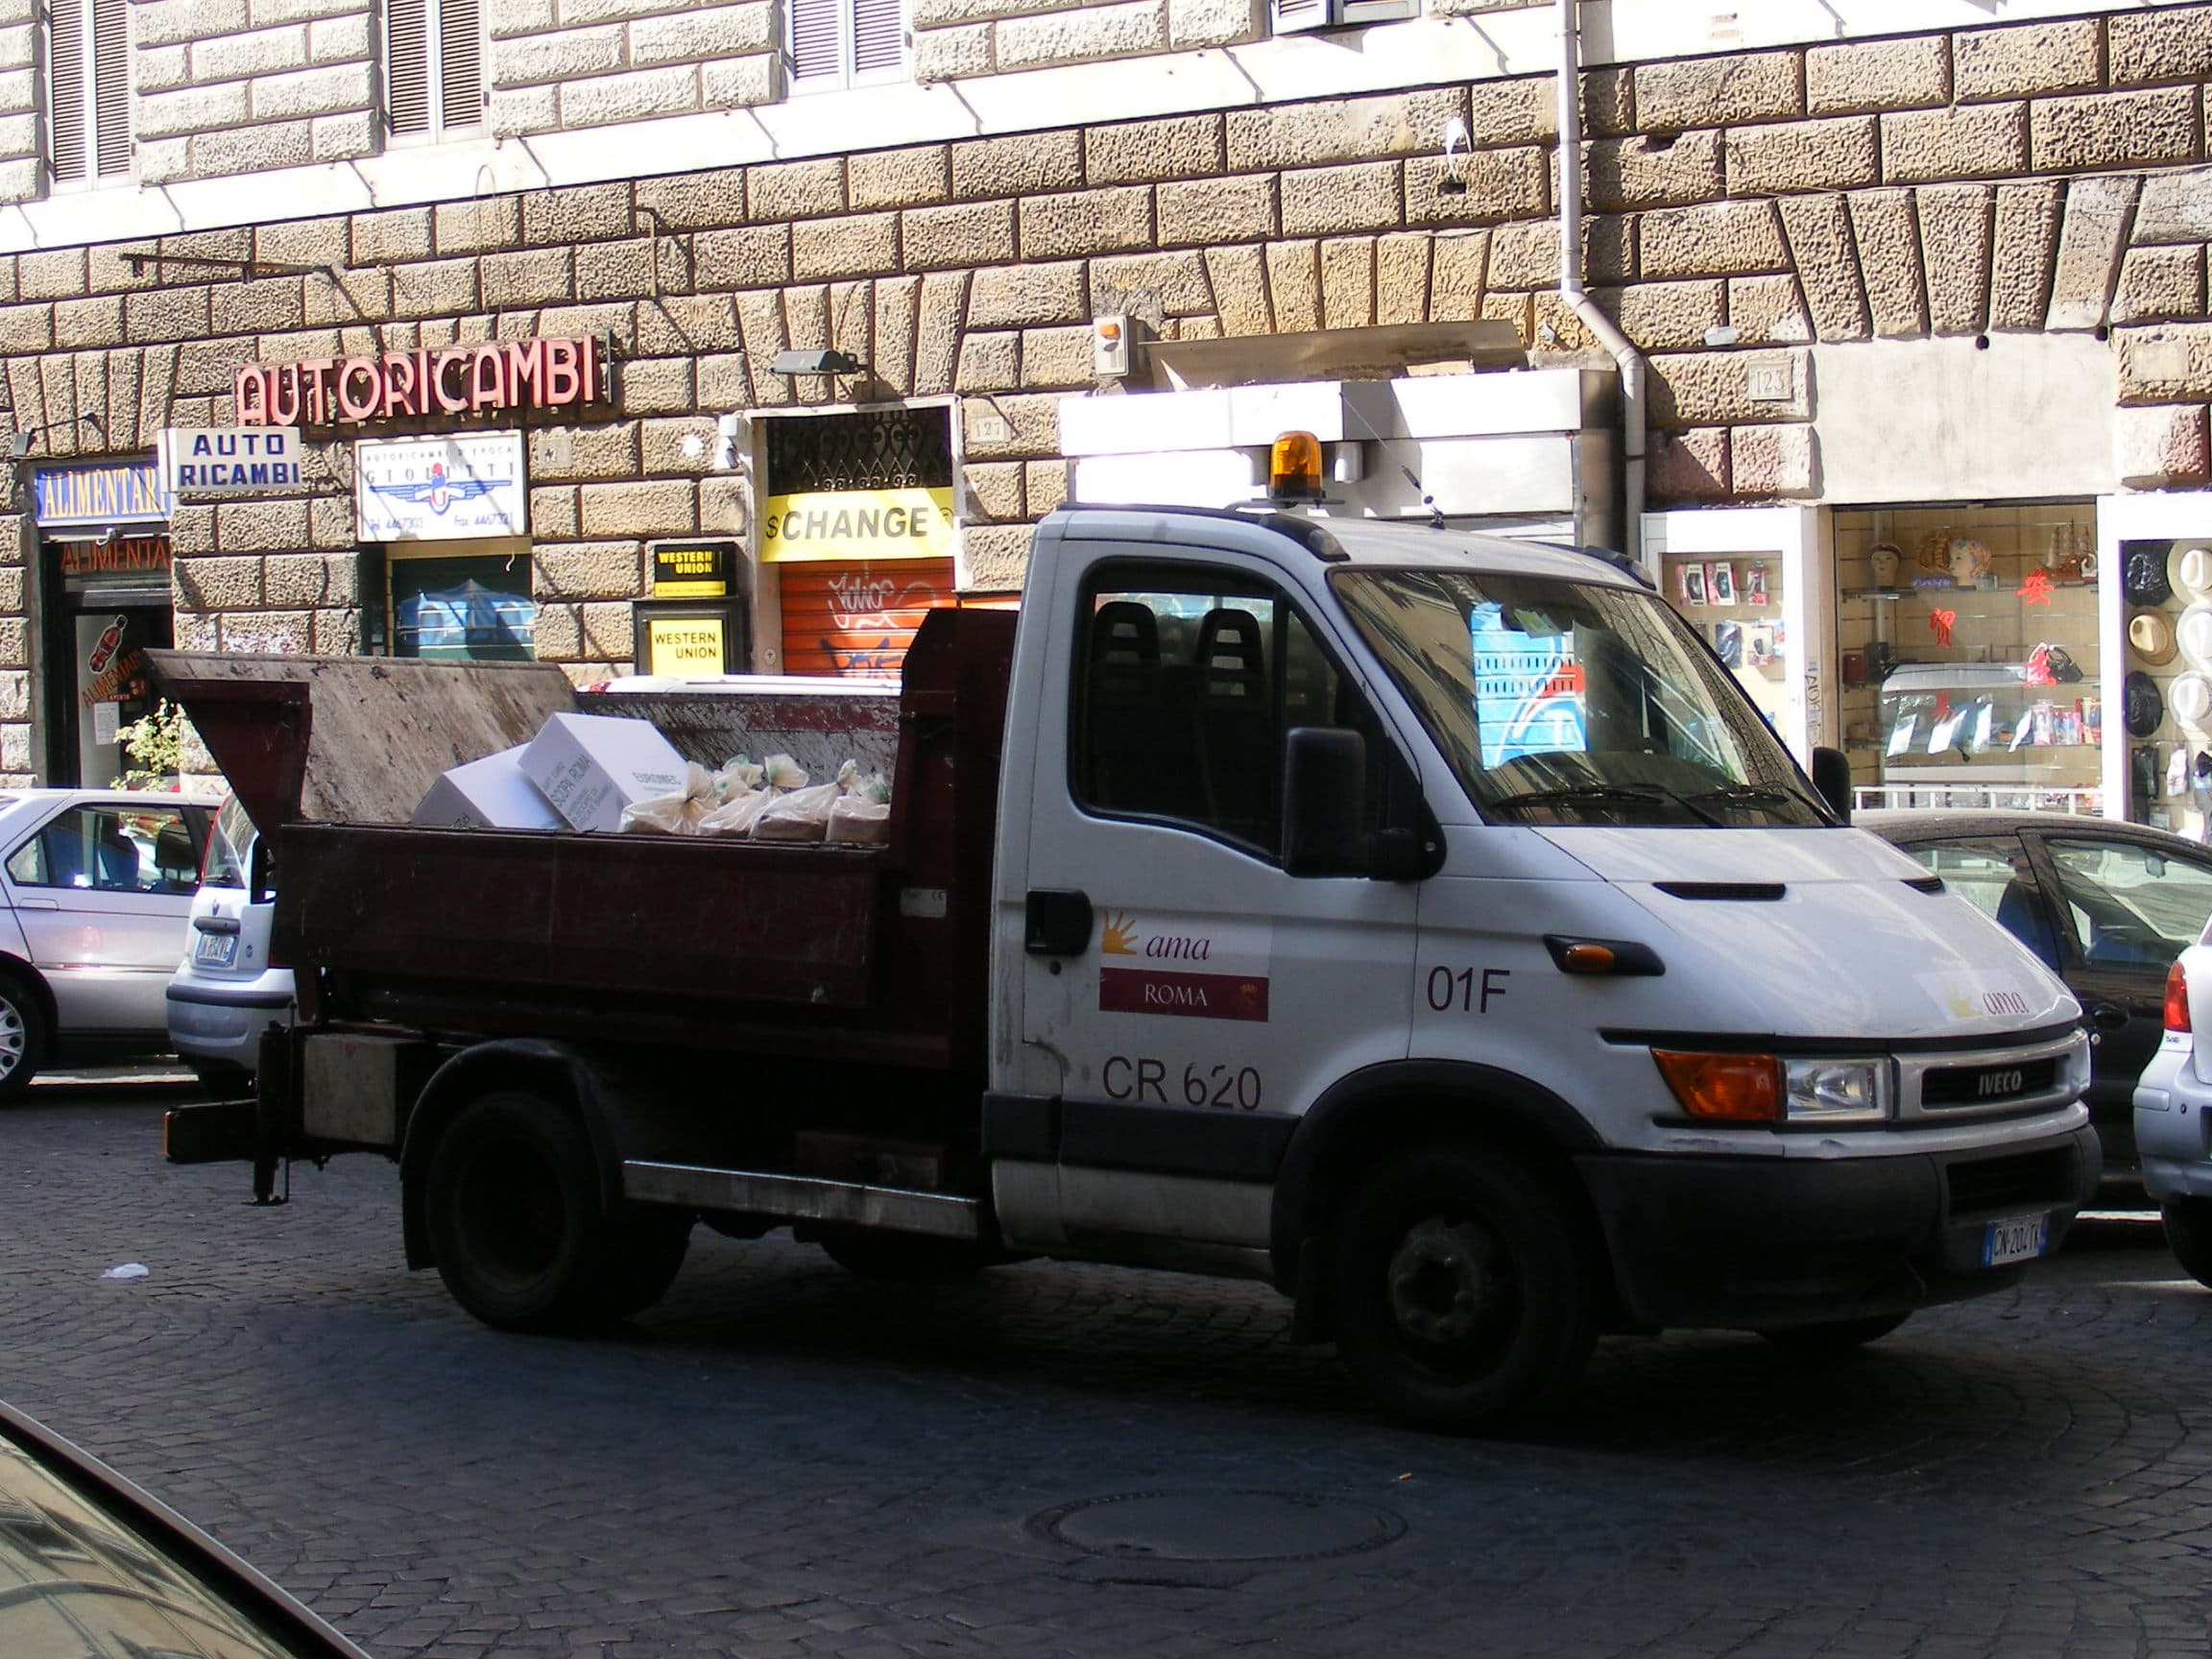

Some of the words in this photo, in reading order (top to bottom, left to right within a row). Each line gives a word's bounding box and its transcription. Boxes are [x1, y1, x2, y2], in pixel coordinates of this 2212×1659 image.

[236, 334, 595, 427] AUTORICAMBI
[1755, 370, 1786, 394] 123
[193, 434, 285, 456] AUTO
[180, 463, 300, 487] RICAMBI
[367, 462, 515, 484] GIOLITTI
[781, 506, 930, 541] CHANGE
[658, 550, 713, 564] WESTERN
[675, 563, 713, 574] UNION
[655, 633, 717, 645] WESTERN
[675, 647, 717, 659] UNION
[1145, 934, 1212, 961] ama
[1145, 983, 1209, 1007] ROMA
[1427, 965, 1511, 1015] 01F
[1982, 991, 2030, 1015] ama
[1102, 1055, 1168, 1104] CR
[1184, 1062, 1262, 1112] 620
[1979, 1070, 2022, 1095] IVECO
